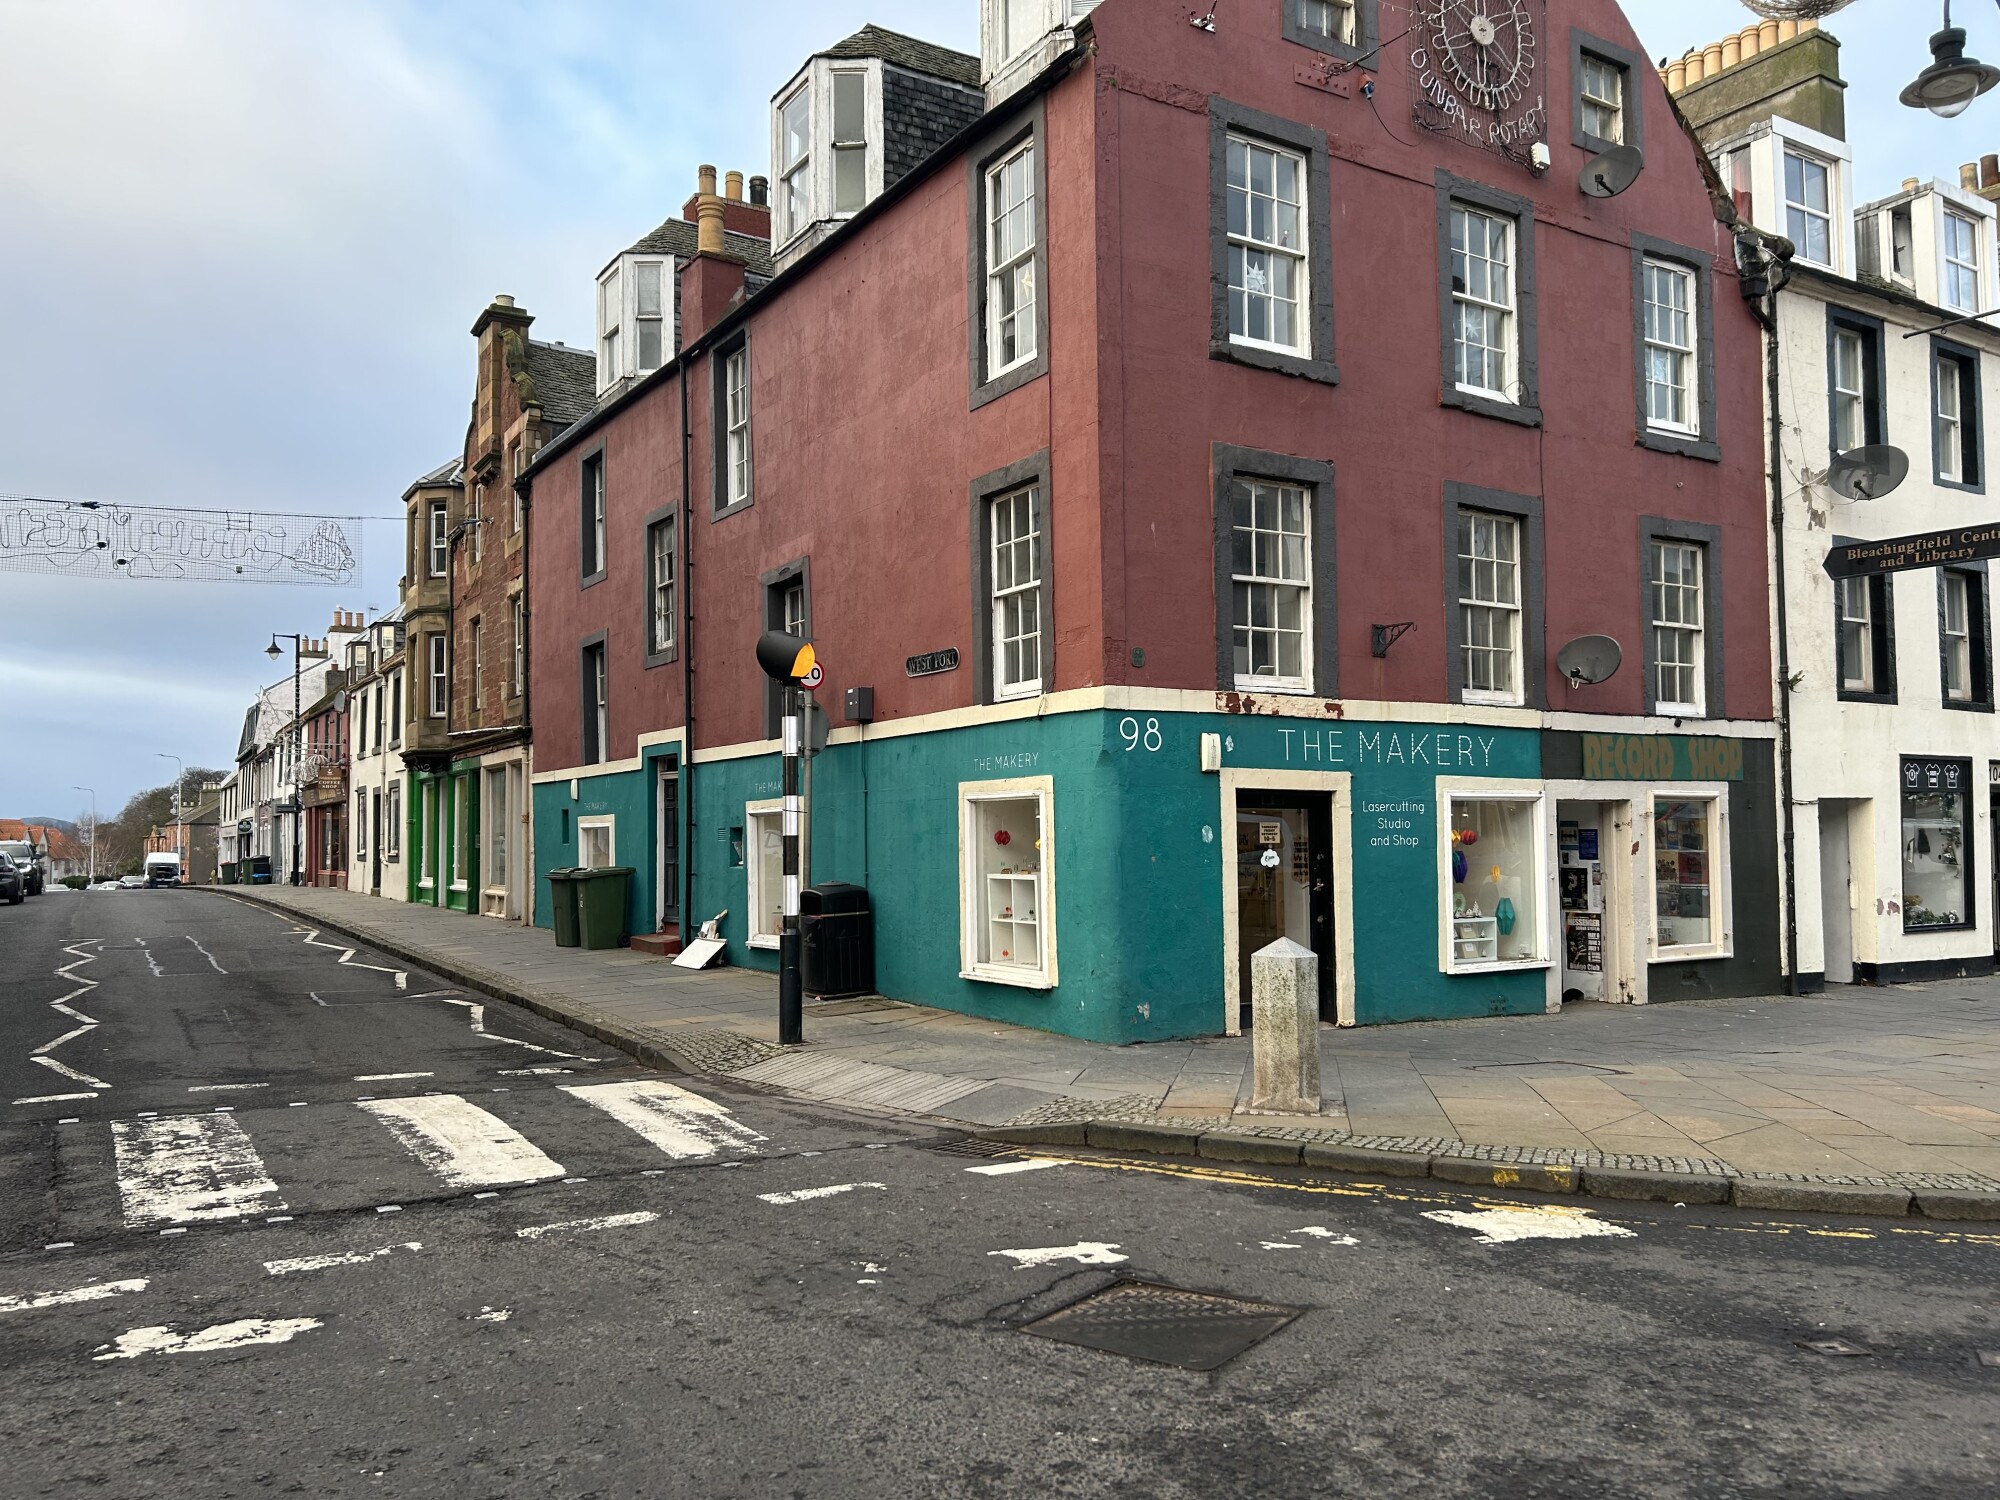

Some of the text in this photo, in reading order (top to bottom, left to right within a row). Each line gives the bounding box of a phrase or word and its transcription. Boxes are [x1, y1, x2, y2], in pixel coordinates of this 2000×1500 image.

[1411, 48, 1546, 145] DUNBAR ROTARY
[1847, 535, 1951, 560] Bleachingfield
[1879, 547, 1976, 568] and Library
[908, 651, 956, 673] WEST PORT
[1119, 716, 1162, 752] 98
[1277, 729, 1495, 767] THE MAKERY
[1583, 734, 1743, 780] RECORD SHOP
[973, 752, 1039, 771] THE MAKERY
[755, 782, 766, 794] THE
[1362, 801, 1425, 815] Lasercutting
[1377, 818, 1411, 829] Studio
[1370, 834, 1419, 848] and Shop
